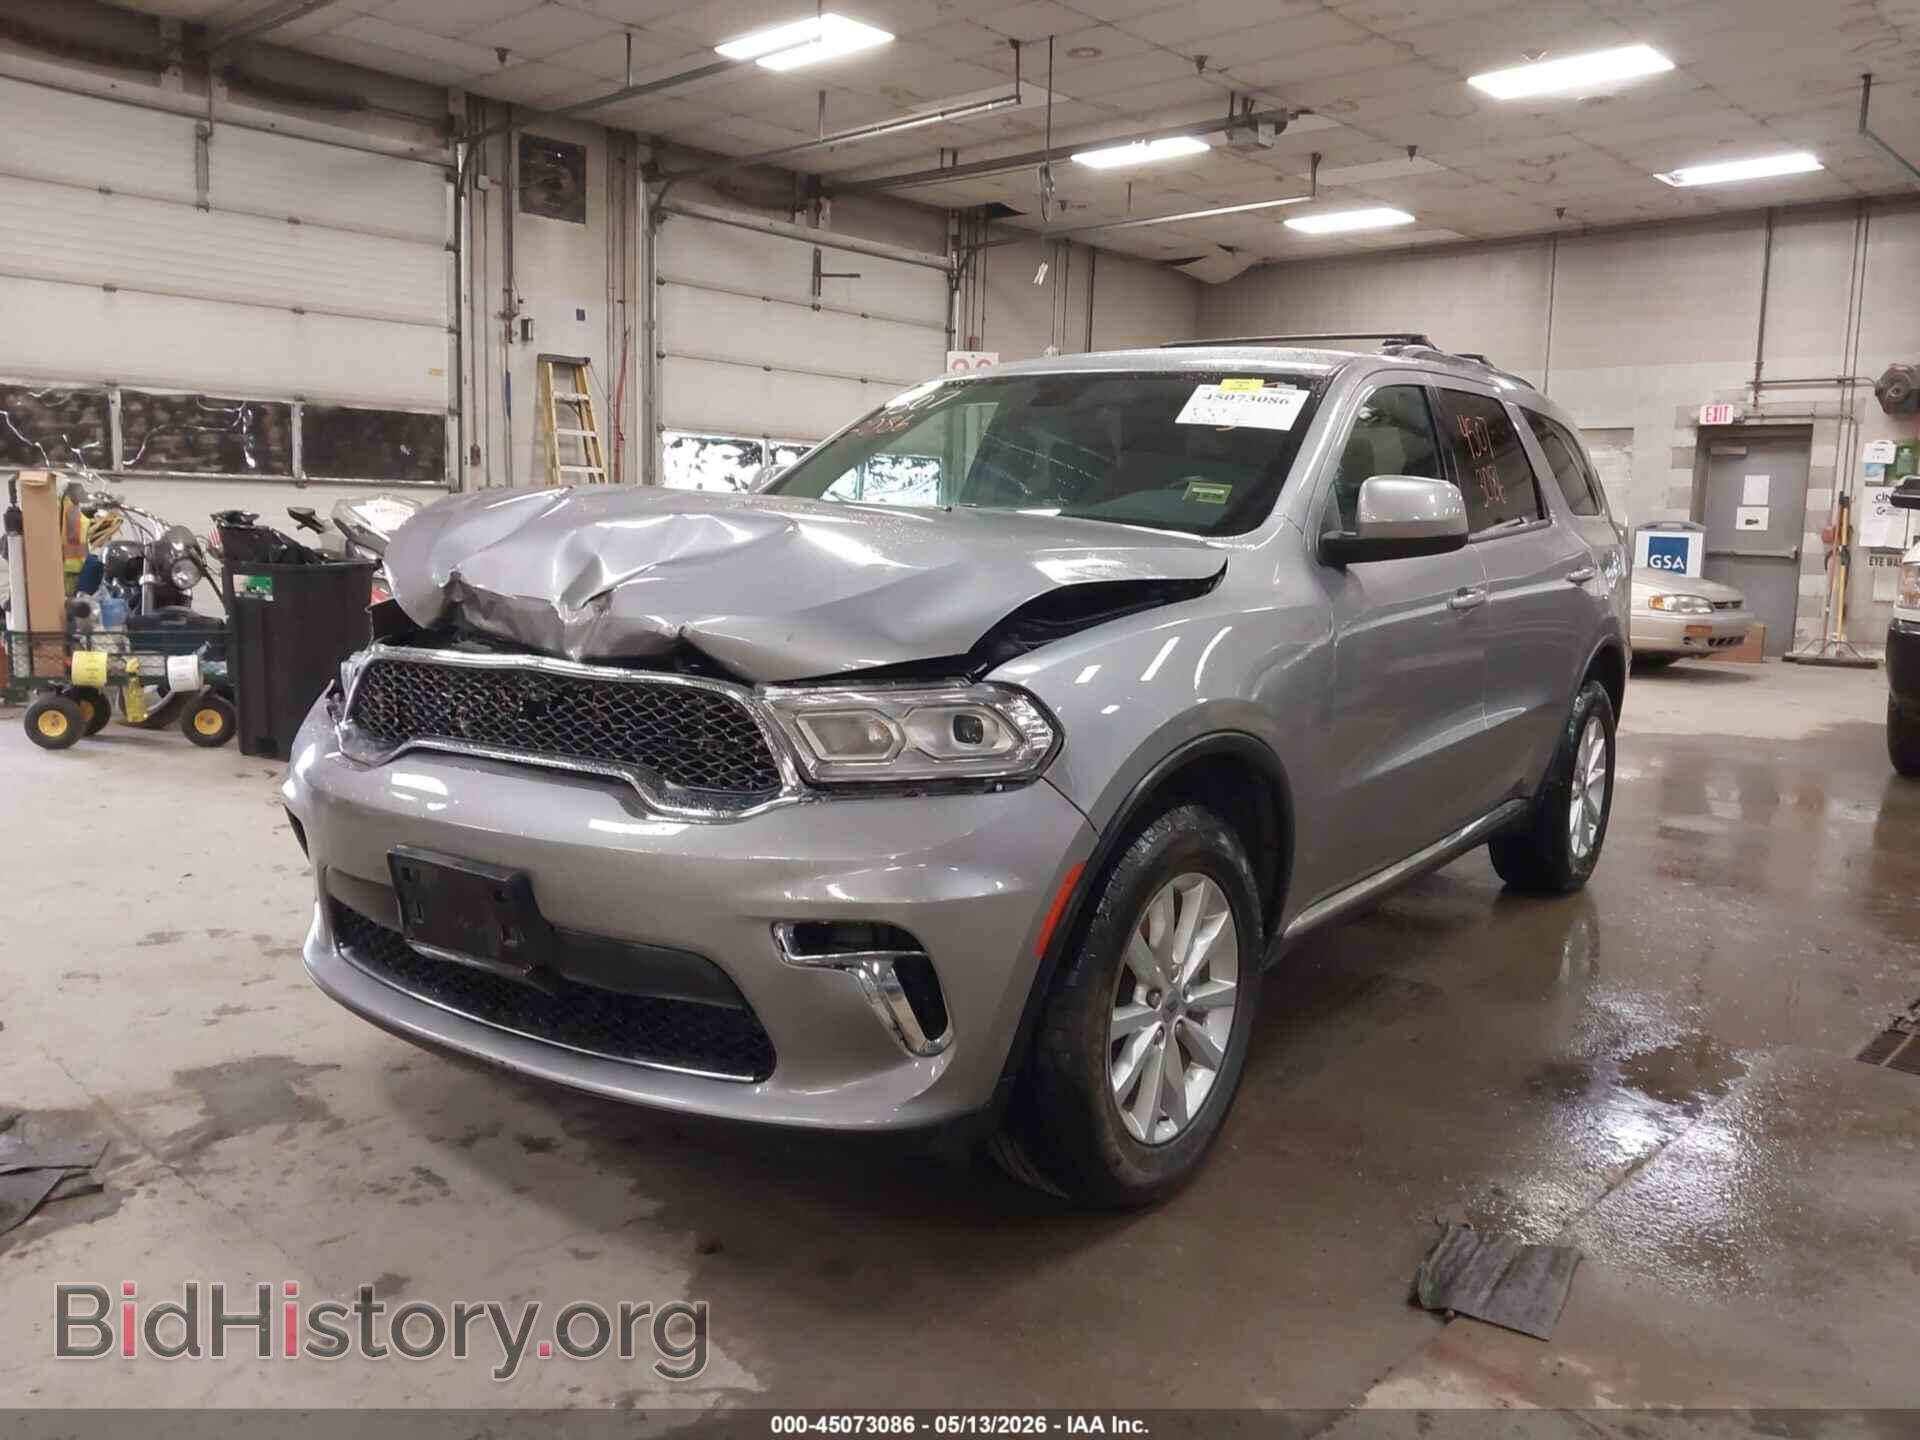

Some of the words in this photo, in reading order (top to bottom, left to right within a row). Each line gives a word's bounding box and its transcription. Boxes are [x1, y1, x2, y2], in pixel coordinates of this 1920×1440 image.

[1705, 406, 1730, 423] EXIT
[1650, 554, 1686, 570] GSA
[1869, 556, 1885, 567] EYE
